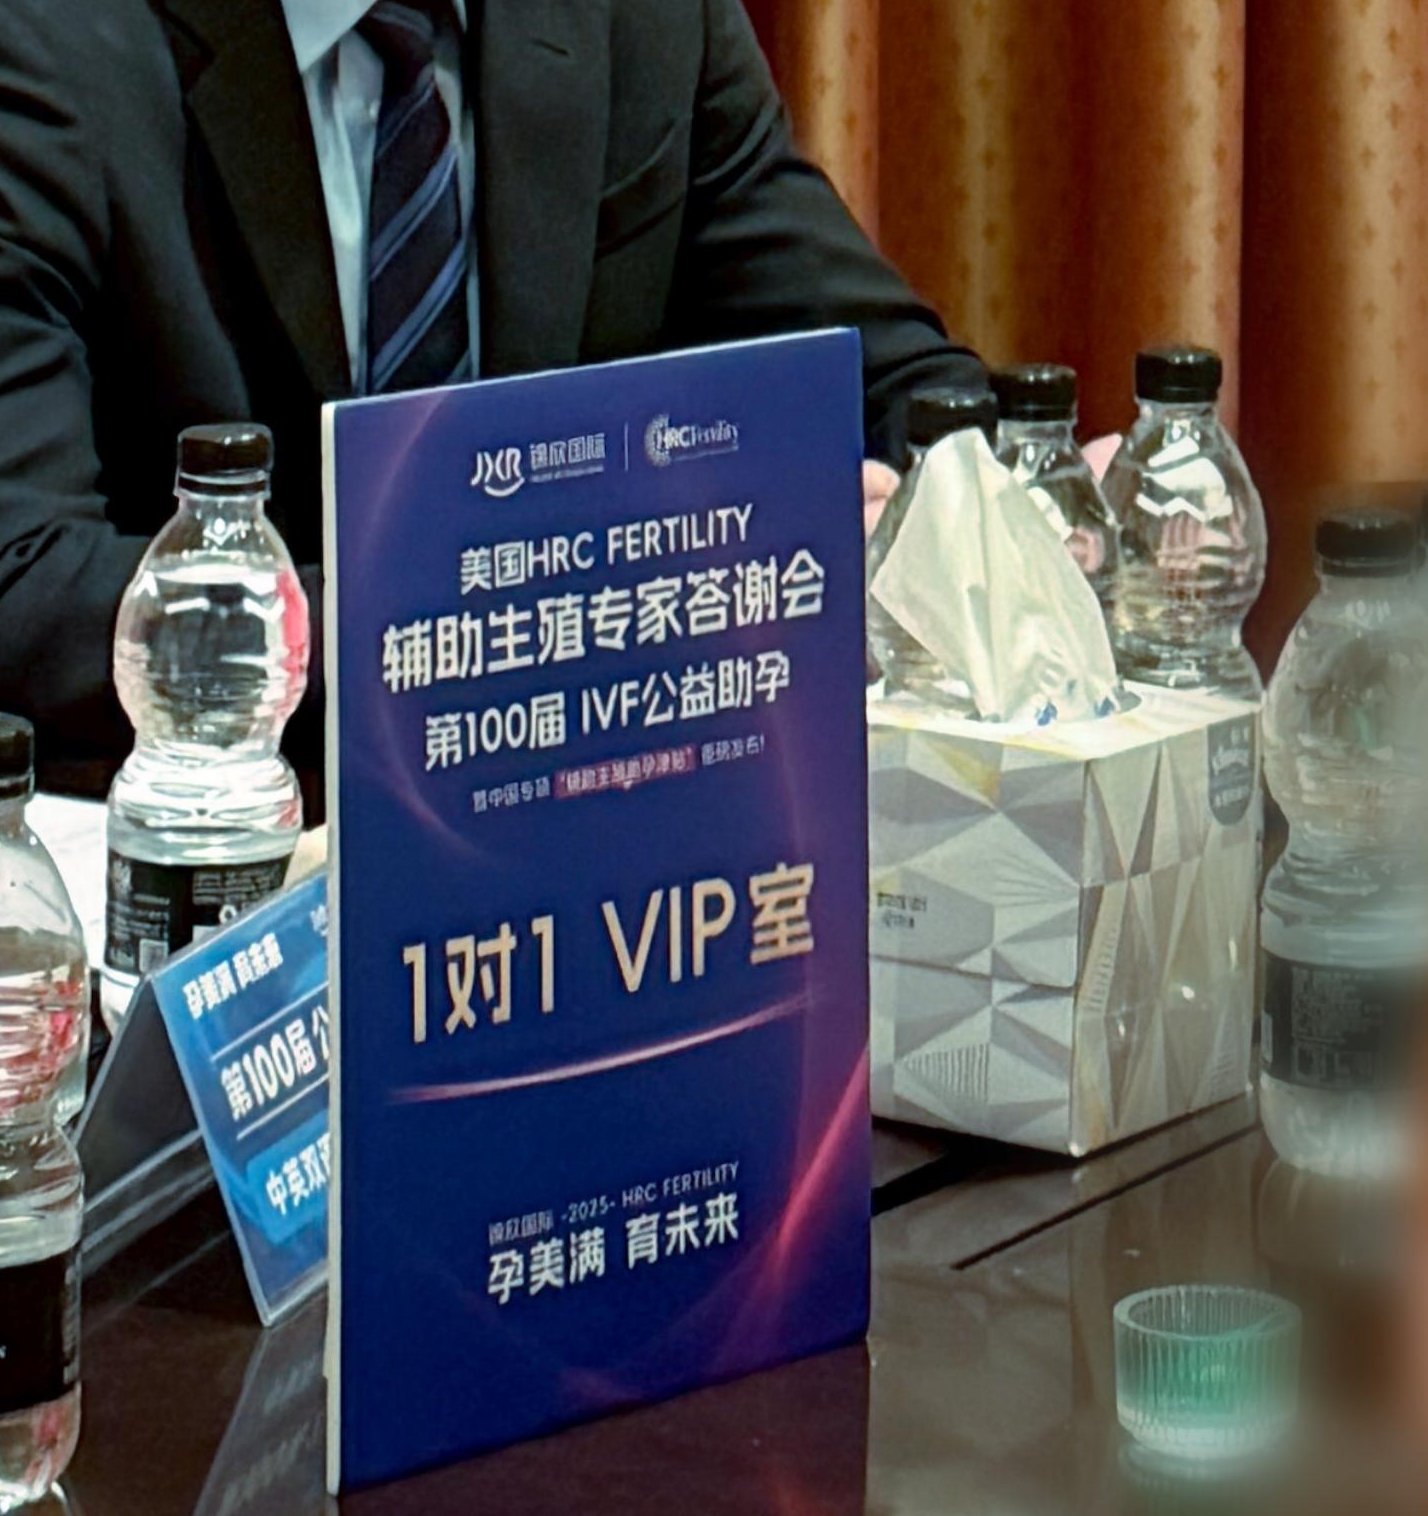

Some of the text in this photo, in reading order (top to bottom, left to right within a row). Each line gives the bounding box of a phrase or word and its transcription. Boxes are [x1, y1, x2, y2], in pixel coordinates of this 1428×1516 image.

[460, 502, 753, 596] 美国HRC FERTILITY
[382, 548, 825, 693] 辅助生殖专家答谢会
[424, 650, 791, 772] 第100届 IVF公益助孕
[402, 914, 555, 1043] 1对1
[601, 861, 815, 993] VIP室
[221, 1018, 318, 1122] 第100届
[622, 1182, 658, 1208] HRC
[663, 1161, 740, 1197] FERTILITY
[488, 1192, 740, 1305] 孕美满 育未来
